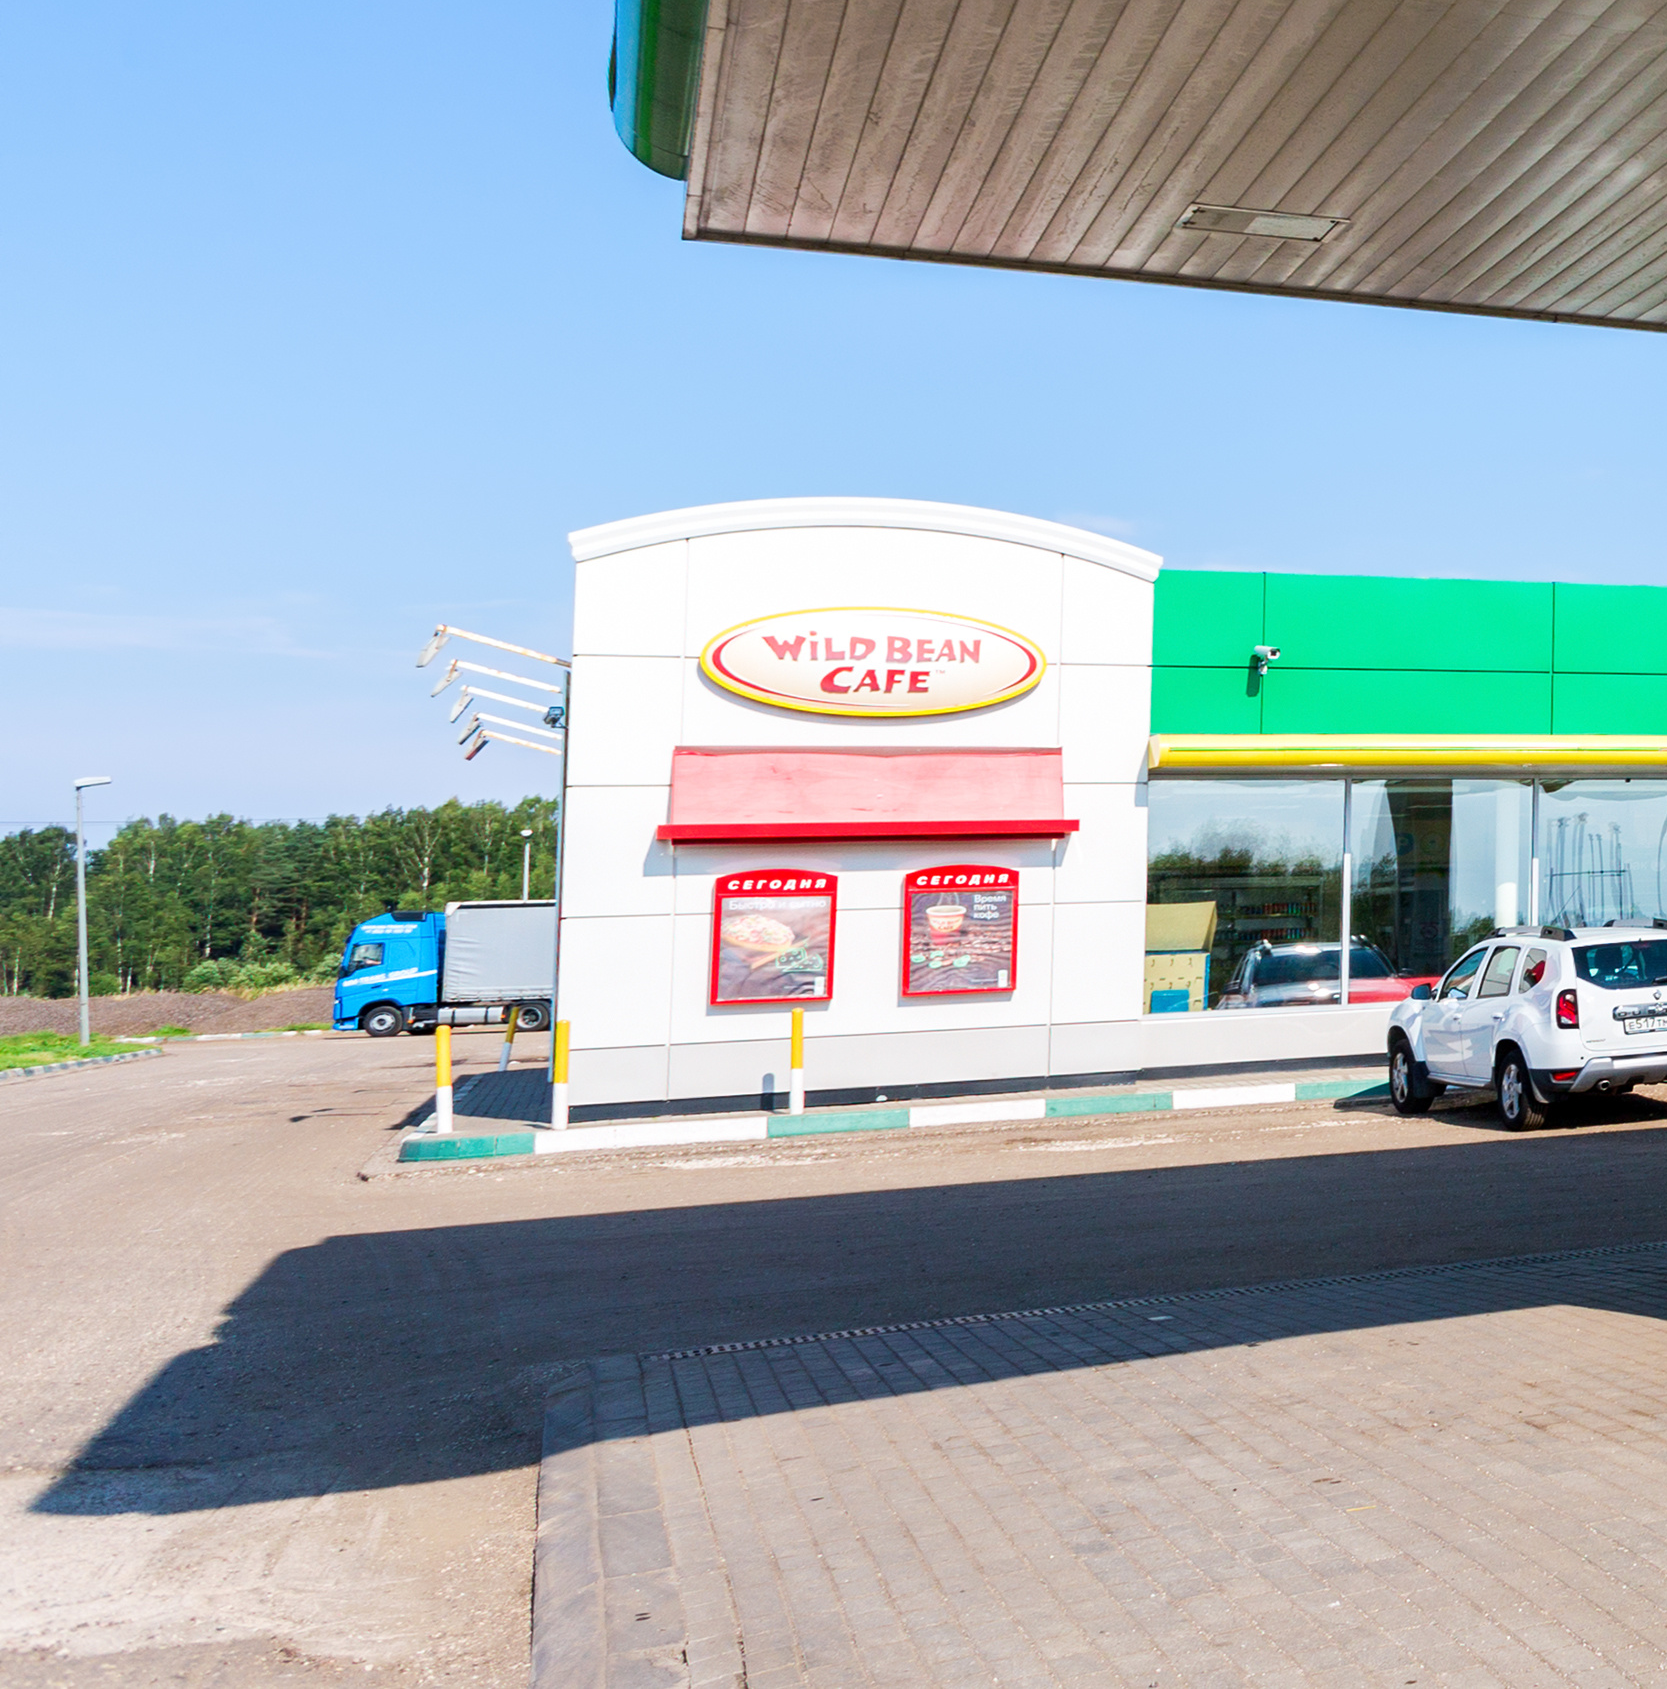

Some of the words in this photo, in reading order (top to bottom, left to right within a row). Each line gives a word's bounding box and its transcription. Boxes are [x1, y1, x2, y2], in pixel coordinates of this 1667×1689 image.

[885, 635, 981, 664] BEAN
[819, 666, 931, 694] CAFE
[727, 878, 827, 891] СЕГОДНЯ
[916, 874, 1009, 886] СЕГОДНЯ
